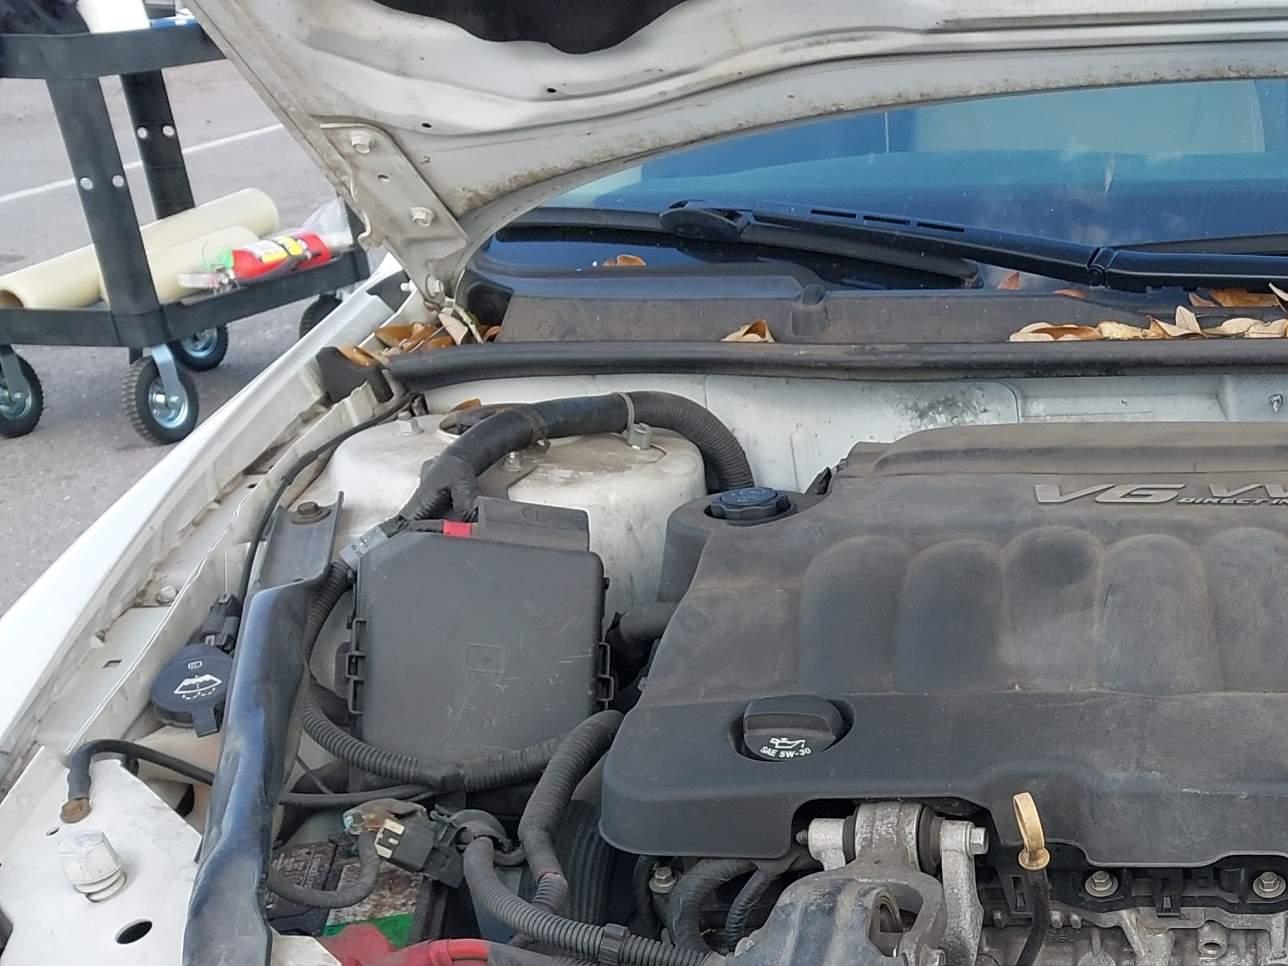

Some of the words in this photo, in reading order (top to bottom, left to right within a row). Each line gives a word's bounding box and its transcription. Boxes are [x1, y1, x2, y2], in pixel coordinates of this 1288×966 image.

[1034, 483, 1187, 504] V6
[1177, 497, 1268, 505] DIRECT
[760, 746, 778, 757] SAE
[779, 747, 811, 758] 5W-30
